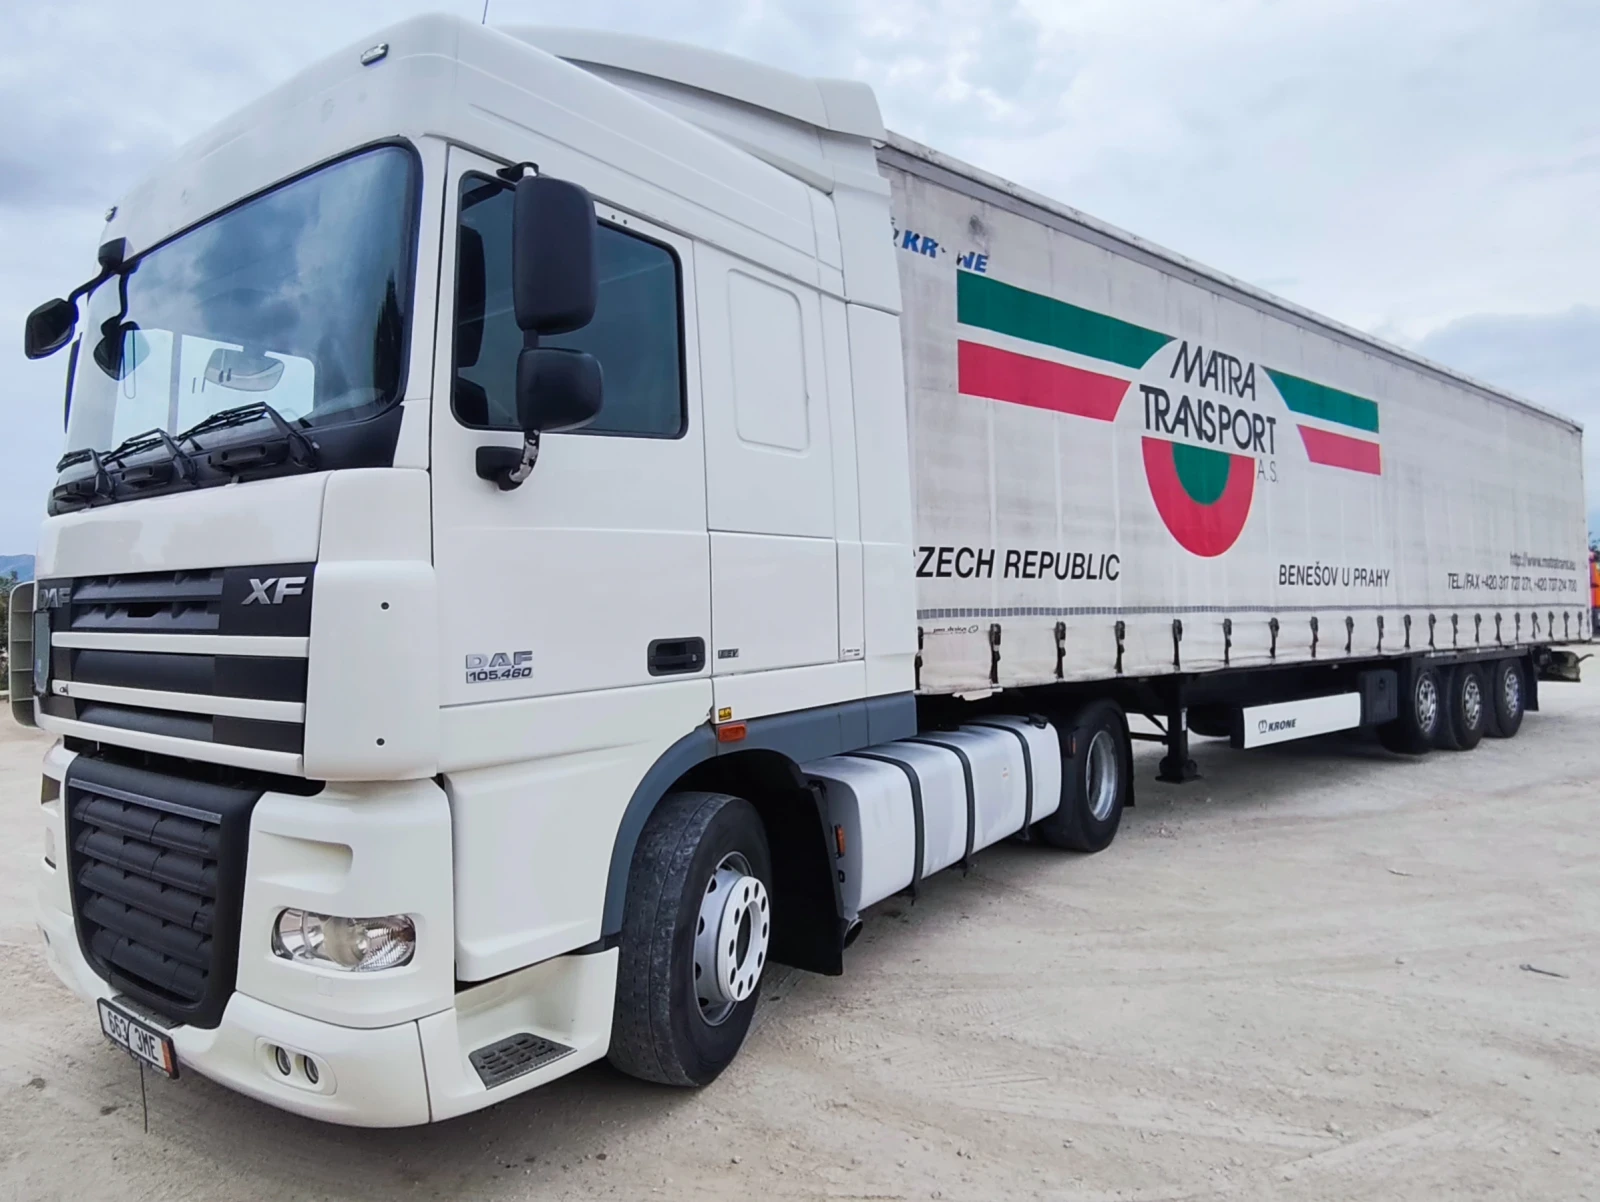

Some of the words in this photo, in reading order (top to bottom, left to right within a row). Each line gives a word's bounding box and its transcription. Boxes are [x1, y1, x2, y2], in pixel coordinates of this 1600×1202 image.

[902, 229, 989, 273] KRNE
[1169, 340, 1256, 402] MATRA
[1139, 383, 1277, 455] TRANSPORT
[1257, 458, 1279, 483] A.S.
[913, 546, 996, 579] ZECH
[1003, 549, 1121, 581] REPUBLIC
[1278, 561, 1339, 587] BENEŠOV
[1341, 567, 1350, 588] U
[1353, 567, 1391, 588] PRAHY
[38, 587, 72, 611] DAF
[241, 576, 308, 605] XF
[465, 650, 533, 669] DAF
[467, 666, 533, 683] 105.460
[1268, 718, 1297, 732] KRONE
[134, 1027, 160, 1062] 3ME
